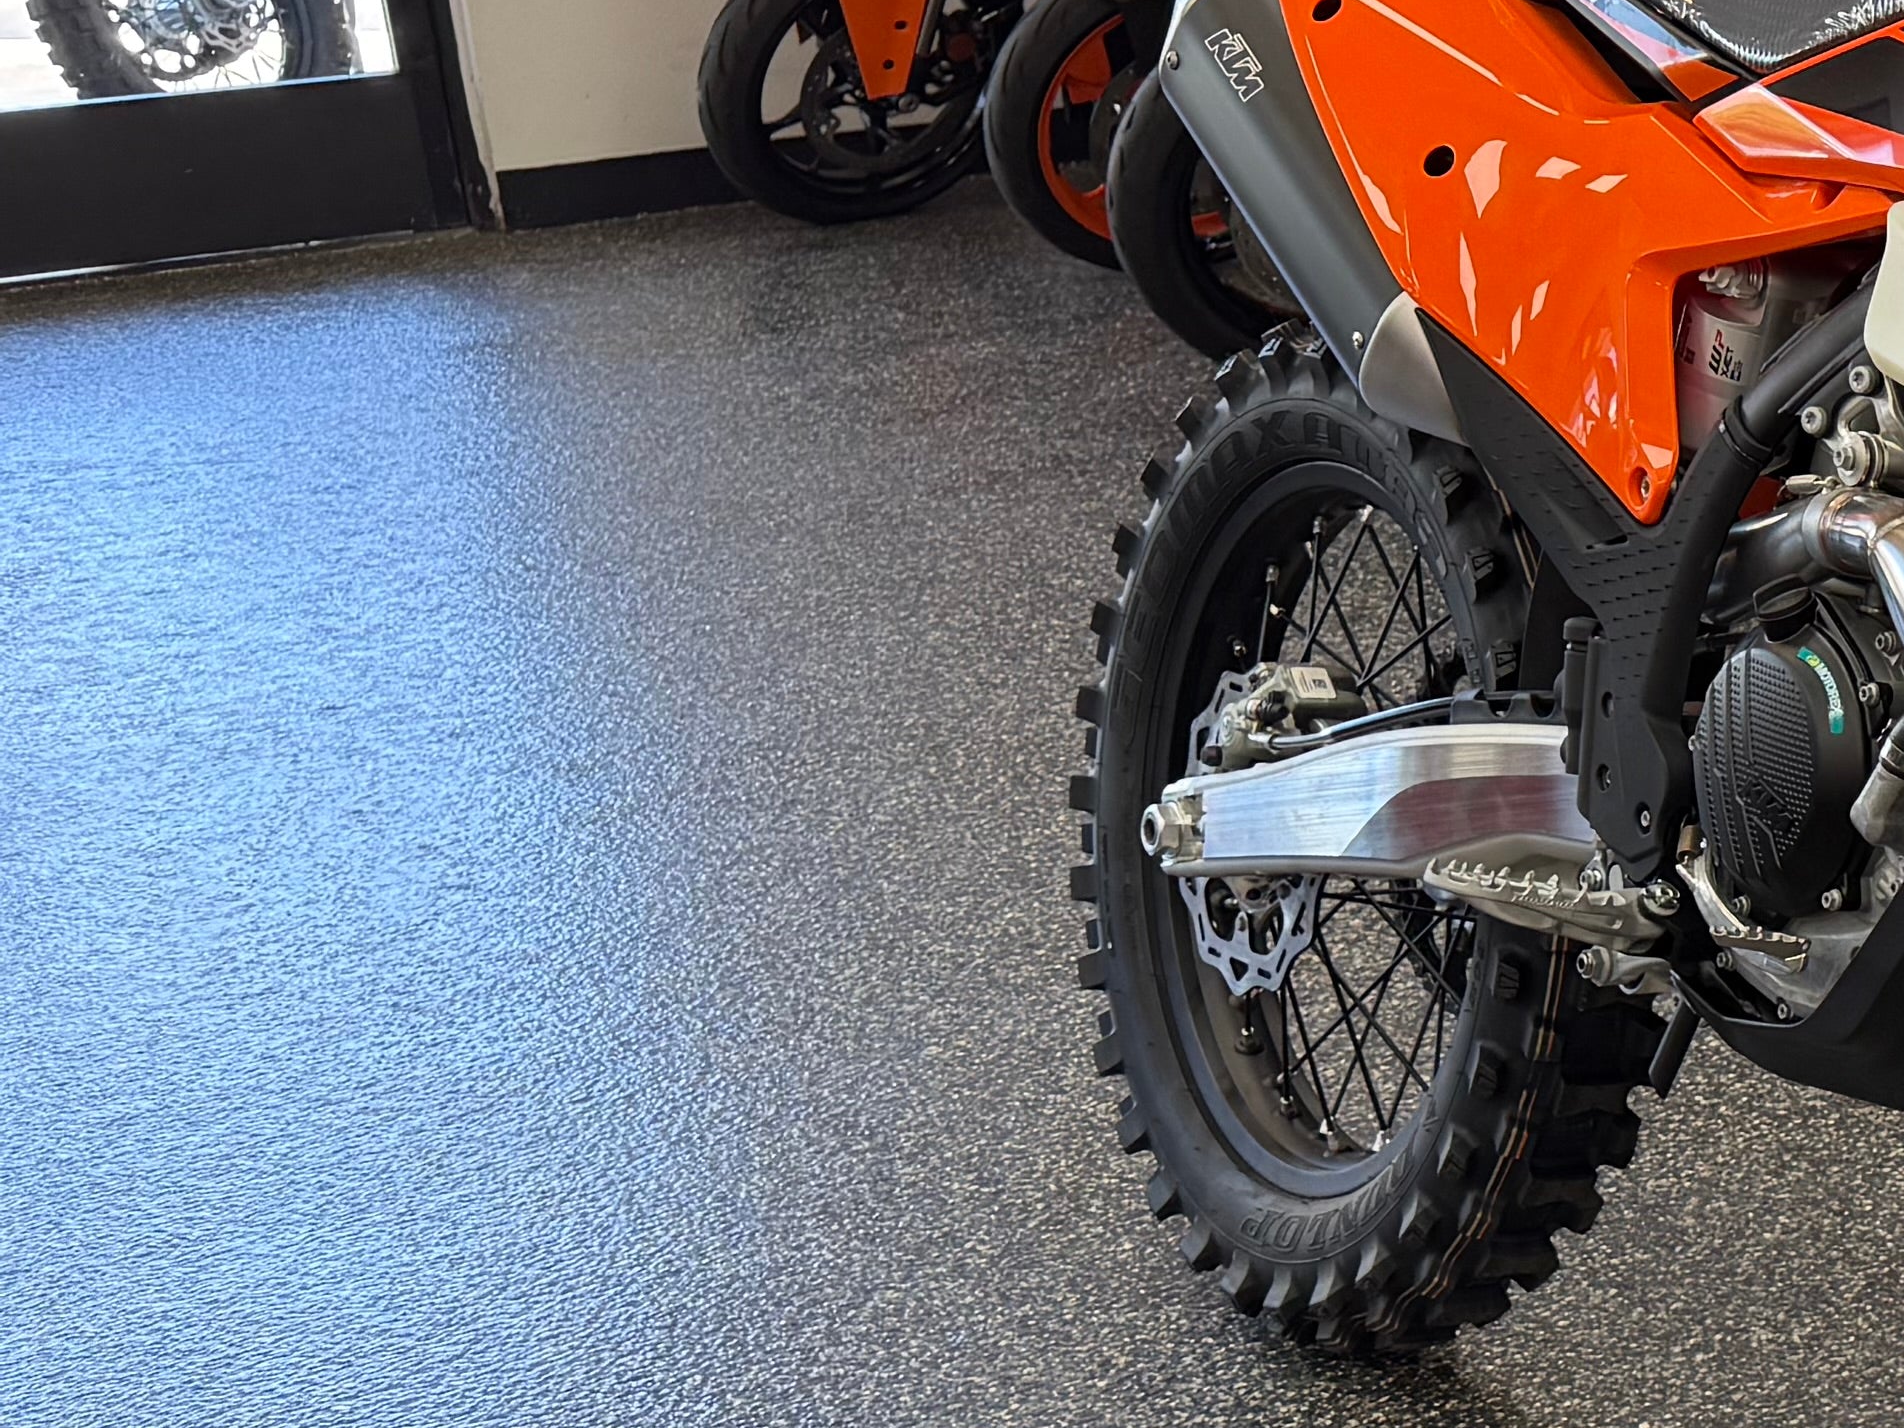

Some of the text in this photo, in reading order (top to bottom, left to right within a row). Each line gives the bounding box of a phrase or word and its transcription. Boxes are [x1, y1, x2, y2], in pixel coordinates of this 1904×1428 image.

[1204, 28, 1264, 103] KTM
[1813, 662, 1847, 717] MOTOREX
[1239, 1149, 1416, 1254] DUNLOP
